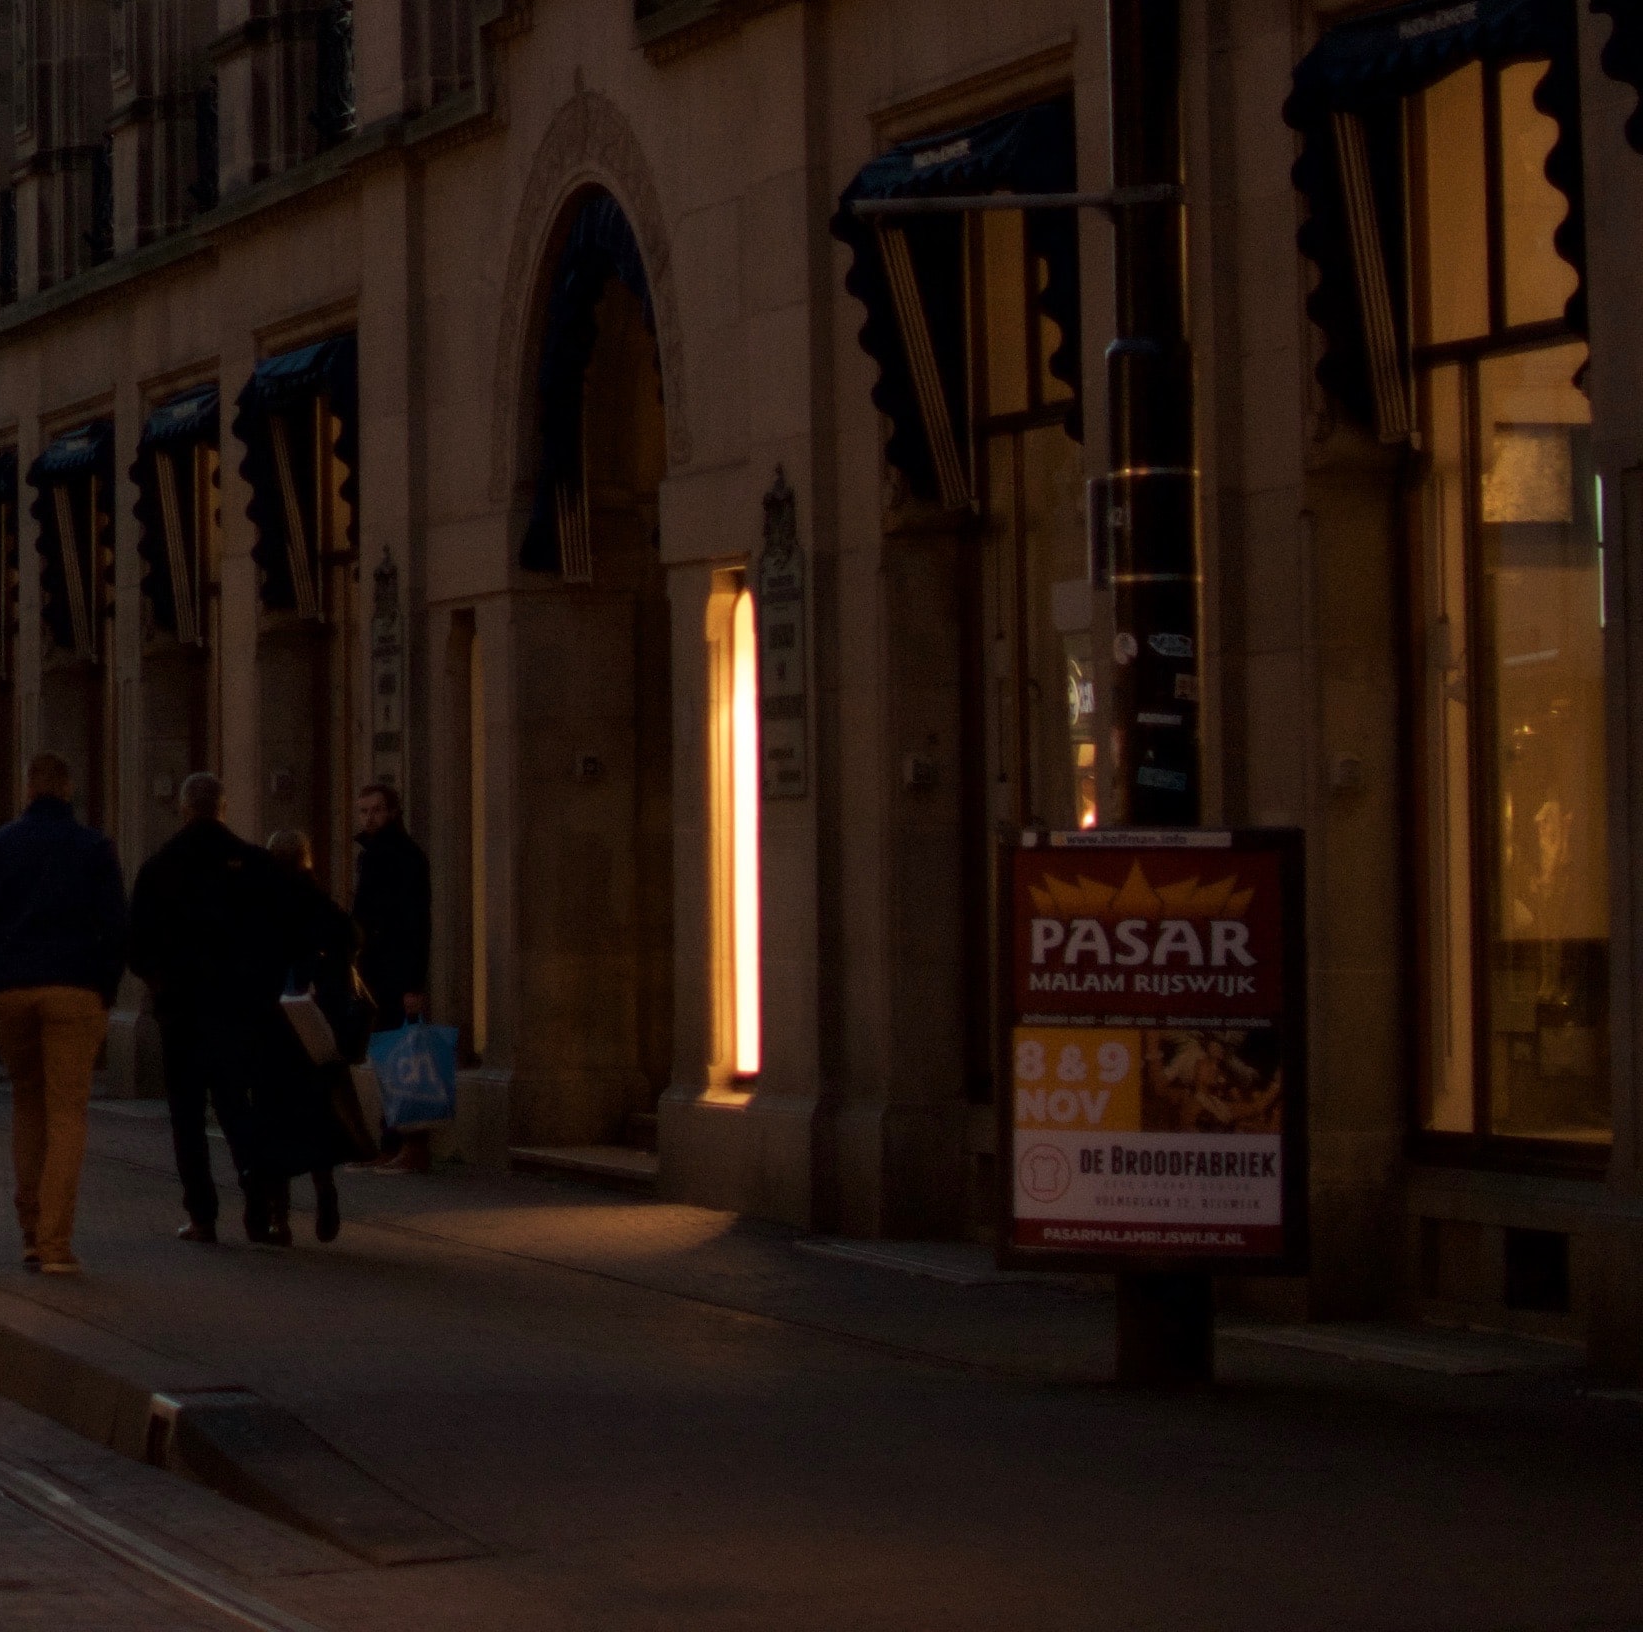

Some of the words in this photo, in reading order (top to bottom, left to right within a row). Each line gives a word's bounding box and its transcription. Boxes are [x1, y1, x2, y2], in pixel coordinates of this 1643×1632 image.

[1030, 918, 1258, 967] PASAR
[1028, 972, 1126, 993] MALAM
[1134, 974, 1257, 997] RIJSWIJK
[1016, 1040, 1046, 1082] 8
[1056, 1045, 1087, 1082] &
[1097, 1042, 1130, 1083] 9
[1016, 1088, 1112, 1125] NOV
[1080, 1149, 1104, 1174] DE
[1043, 1227, 1246, 1246] PASARMALAMRIJSWIJK.NL
